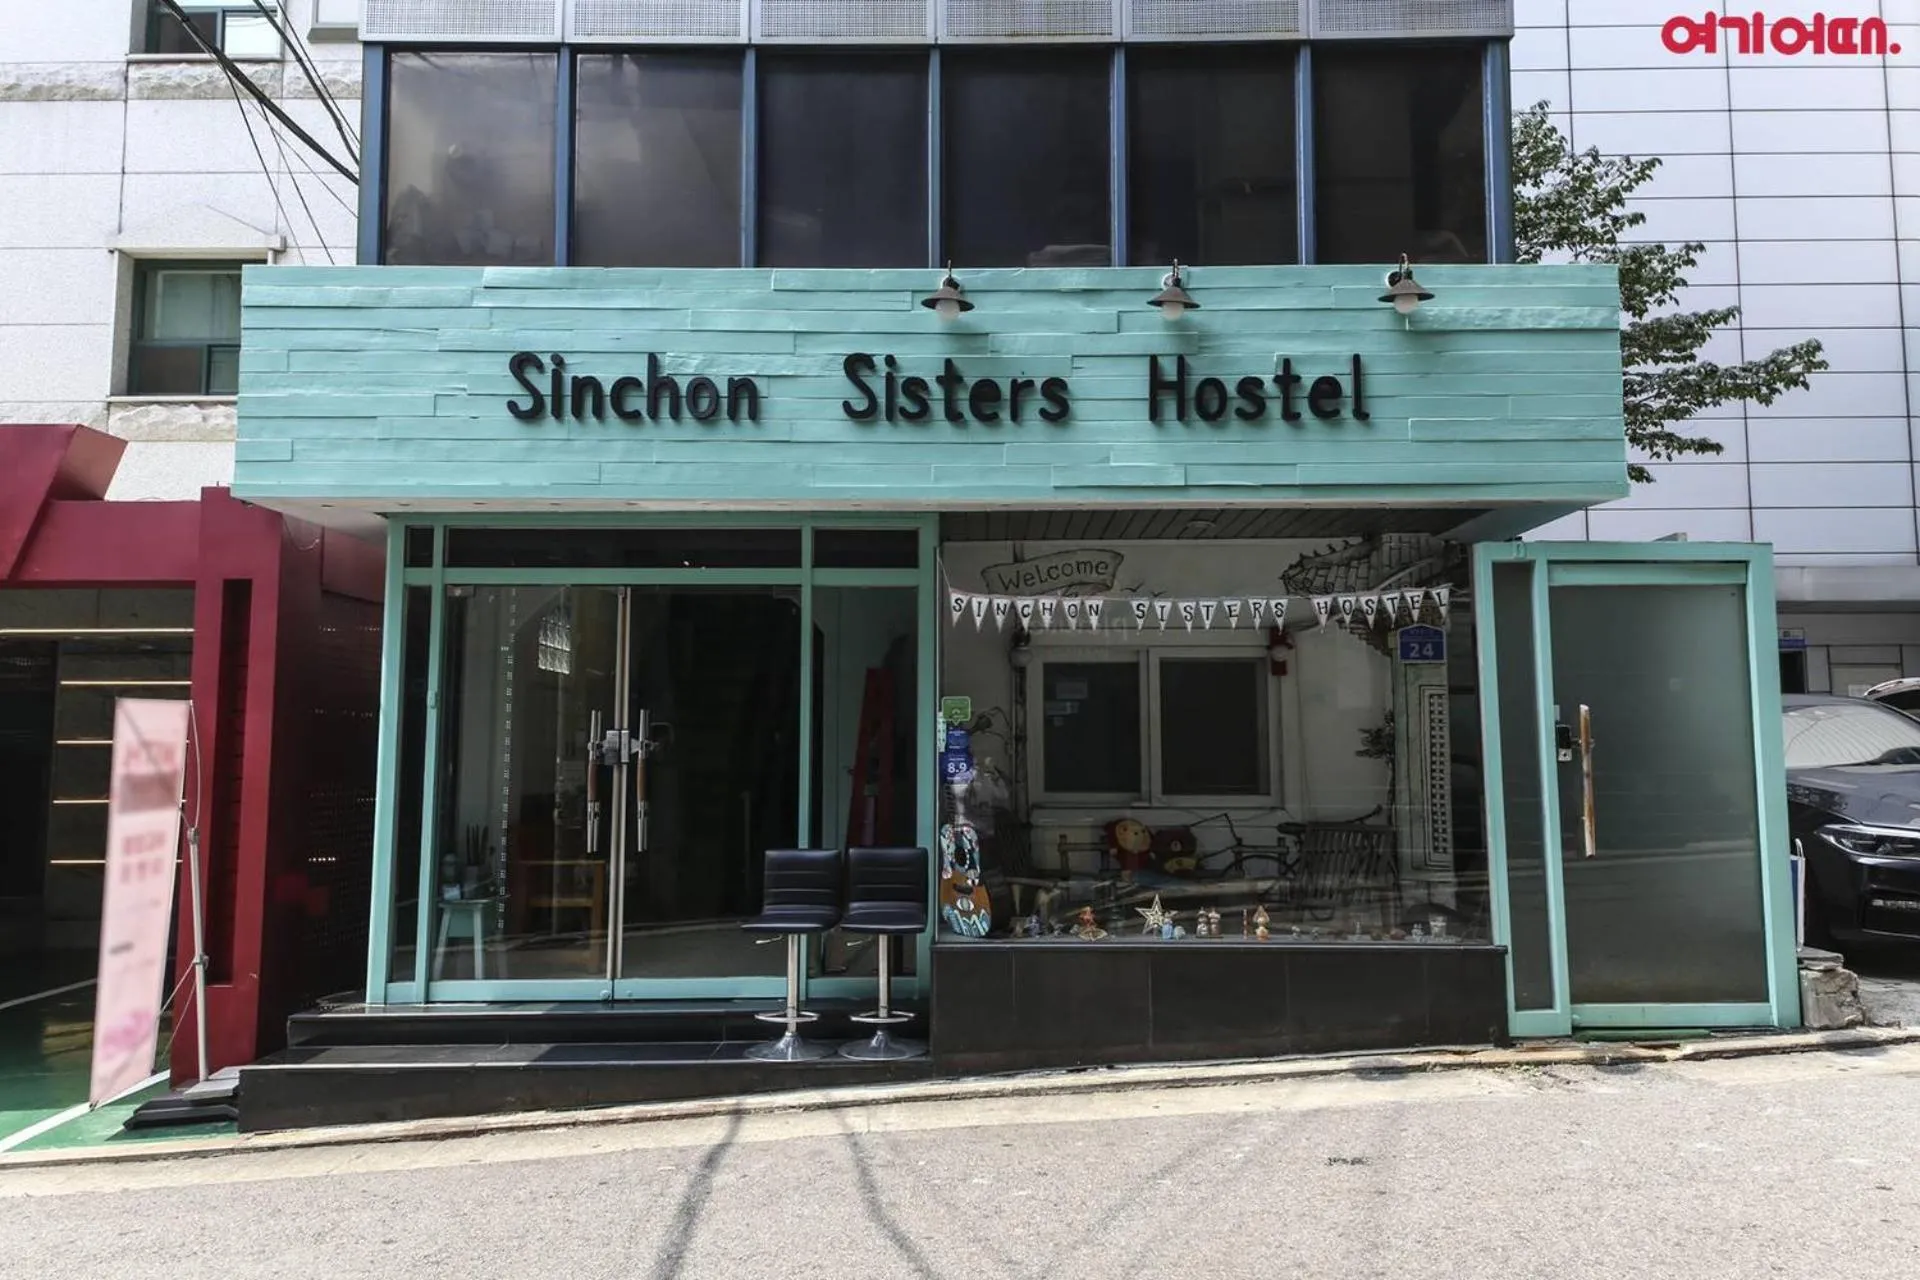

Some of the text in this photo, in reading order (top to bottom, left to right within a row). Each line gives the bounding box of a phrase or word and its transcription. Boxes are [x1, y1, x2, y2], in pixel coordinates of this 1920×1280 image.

[506, 351, 1371, 426] Sinchon Sisters Hostel
[998, 559, 1108, 592] Welcome
[952, 591, 1447, 622] SINCHON SISTERS HOSTEL
[1409, 643, 1435, 659] 24
[947, 762, 968, 773] 8.9
